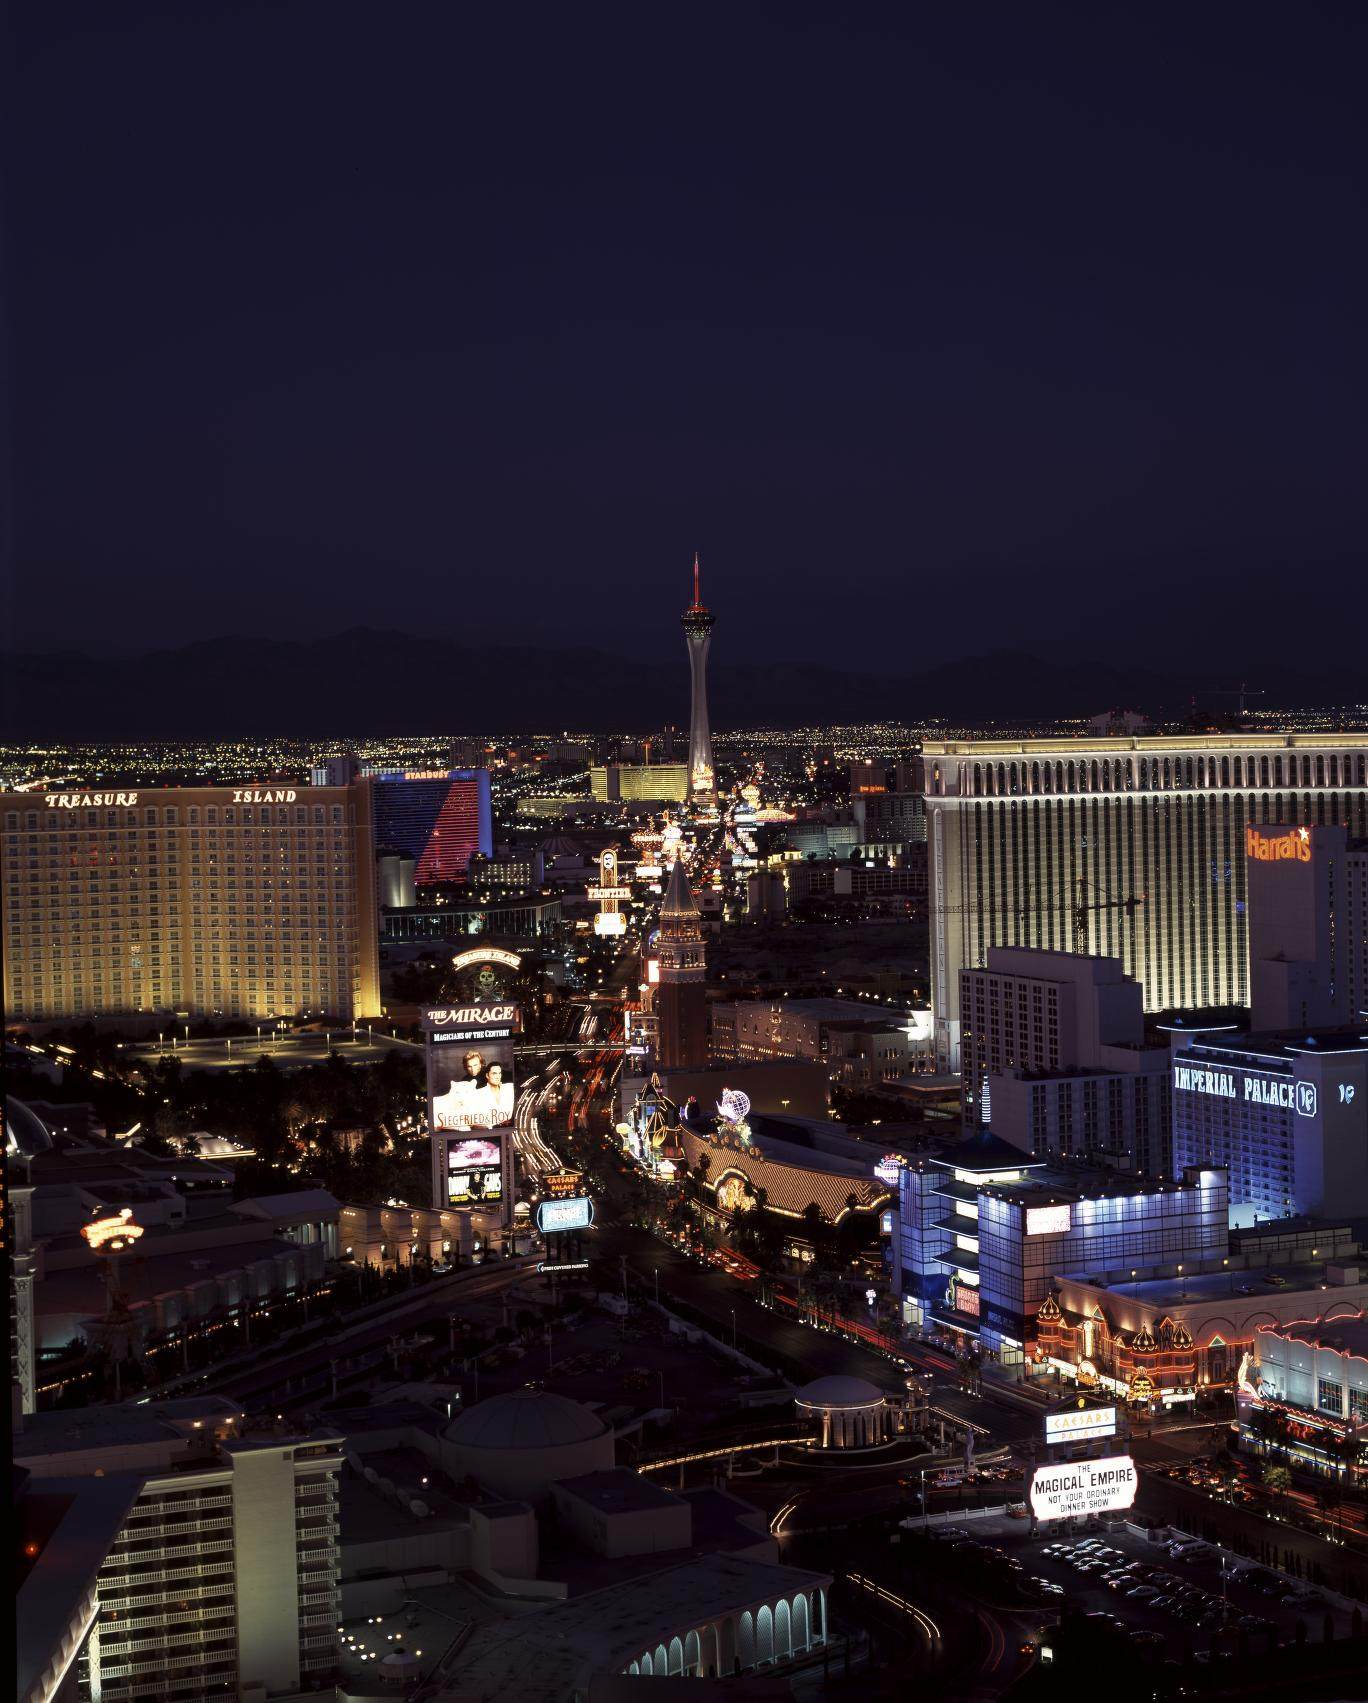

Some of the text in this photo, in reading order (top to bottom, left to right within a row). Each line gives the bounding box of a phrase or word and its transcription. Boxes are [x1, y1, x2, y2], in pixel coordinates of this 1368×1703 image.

[405, 770, 449, 780] STARDUST
[45, 790, 297, 808] TREASURE ISLAND
[427, 1006, 514, 1024] THE MIRAGE
[1174, 1066, 1295, 1108] IMPERIAL PALACE
[437, 1113, 485, 1127] SIEGFRIED
[491, 1108, 511, 1124] ROY
[1054, 1411, 1110, 1429] CAESARS
[1078, 1465, 1091, 1473] THE
[1035, 1468, 1133, 1495] MAGICAL EMPIRE
[1048, 1487, 1120, 1504] NOT YOUR ORDINARY
[1061, 1498, 1109, 1513] DINNER SHOW
